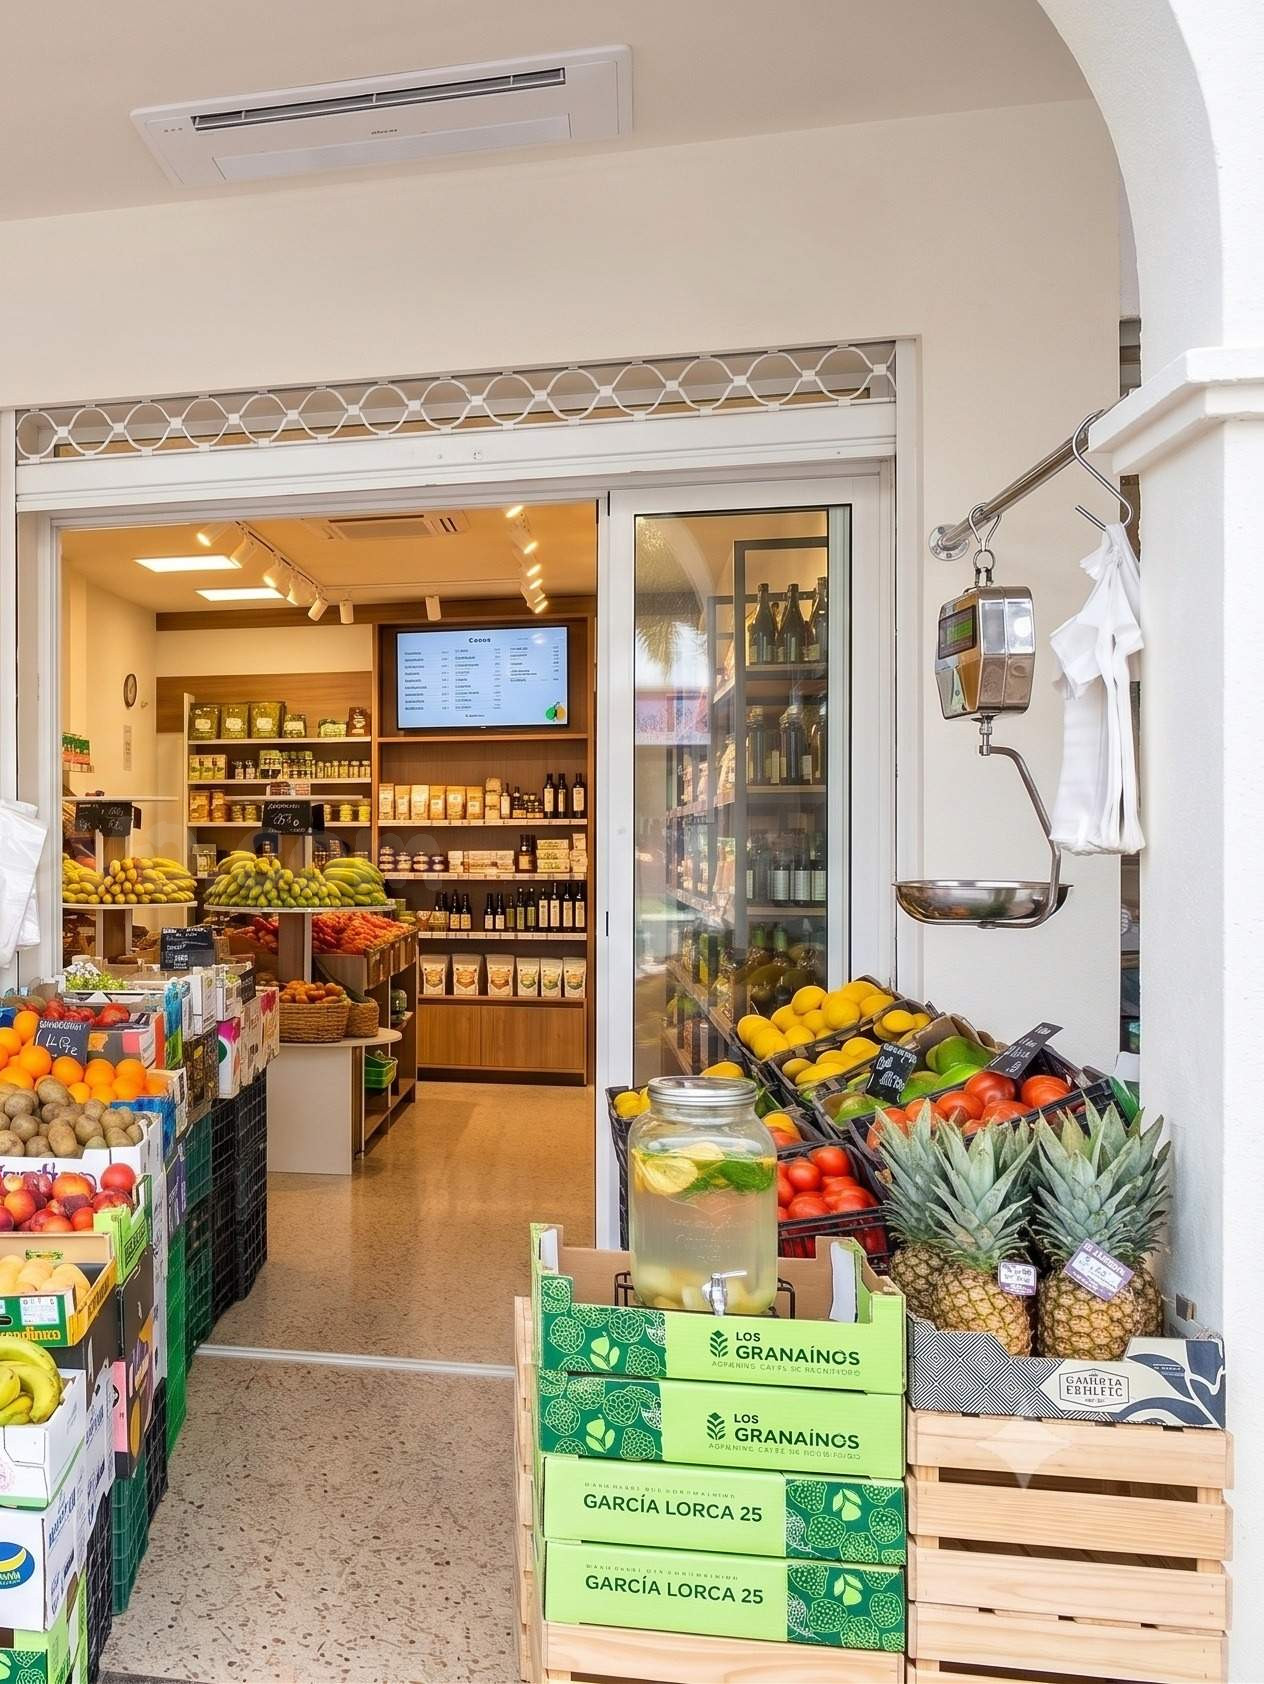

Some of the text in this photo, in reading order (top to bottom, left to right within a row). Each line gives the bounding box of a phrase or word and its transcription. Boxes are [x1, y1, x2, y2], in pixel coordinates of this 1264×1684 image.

[736, 1331, 761, 1342] LOS
[734, 1413, 759, 1424] LOS
[583, 1494, 763, 1522] GARCÍA LORCA 25
[585, 1575, 764, 1605] GARCÍA LORCA 25
